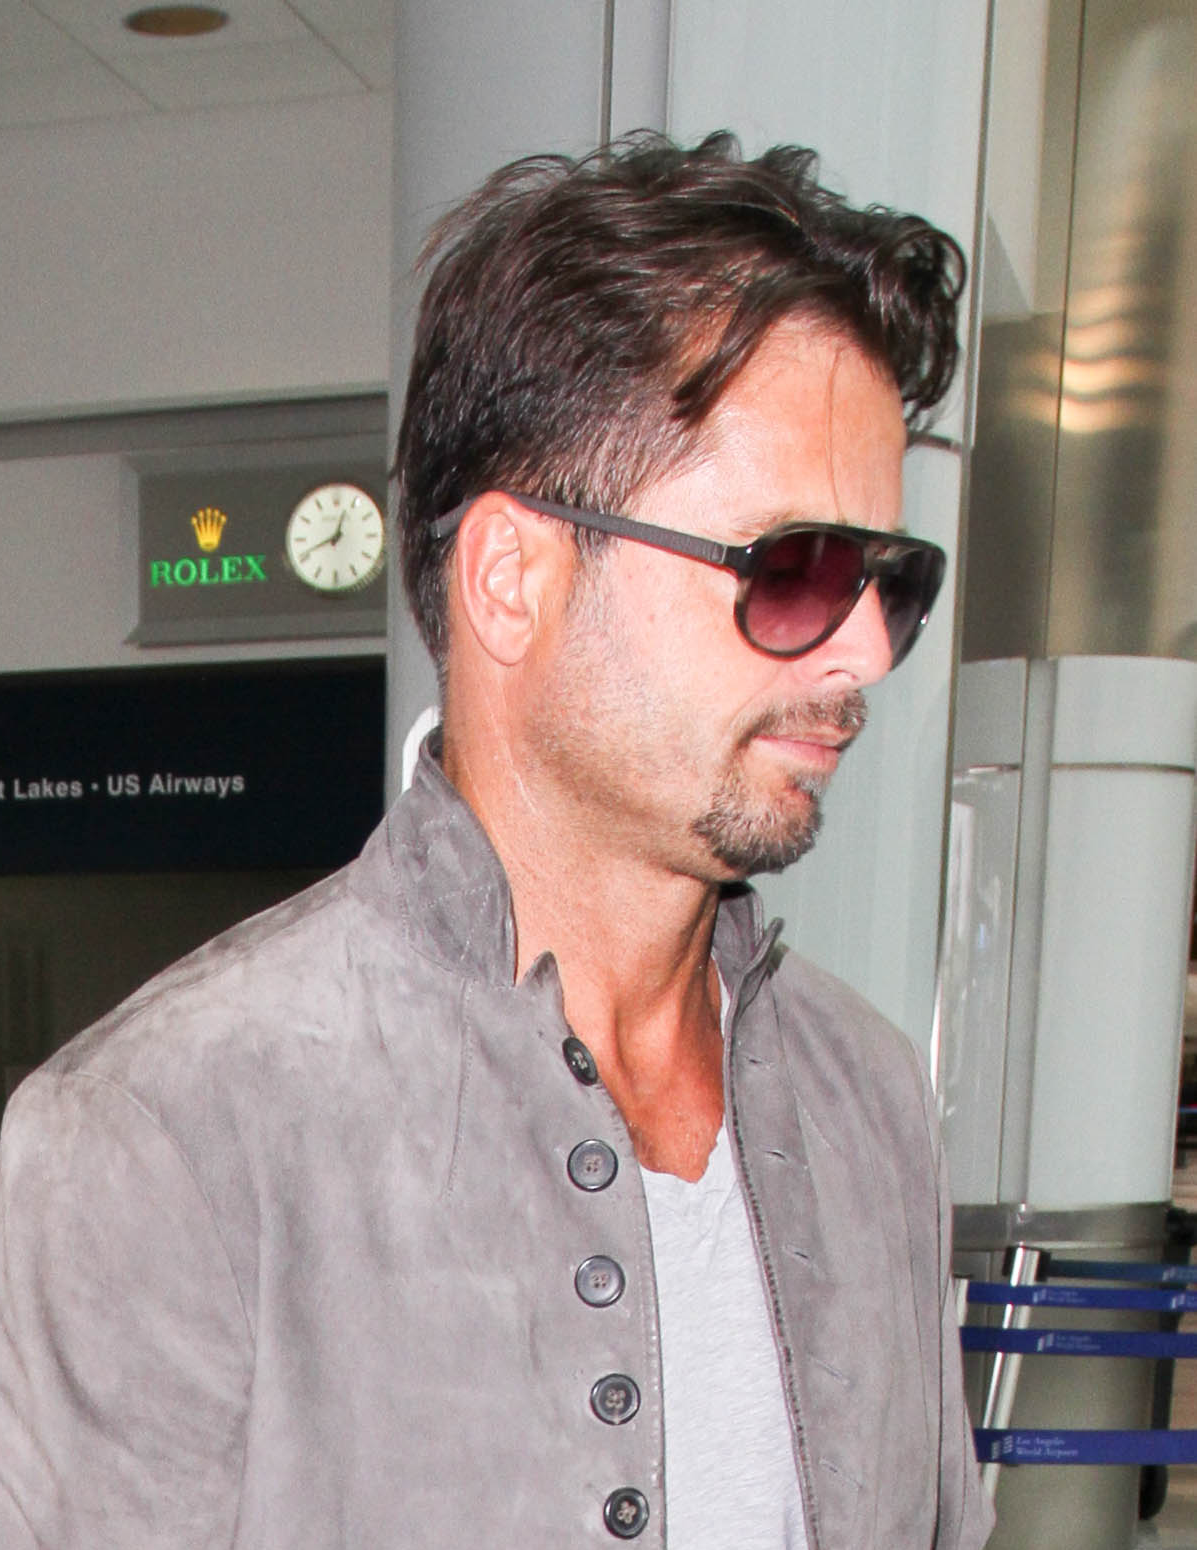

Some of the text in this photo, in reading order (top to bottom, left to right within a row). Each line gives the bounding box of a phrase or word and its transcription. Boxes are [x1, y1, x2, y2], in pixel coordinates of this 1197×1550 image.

[151, 554, 267, 587] ROLEX
[13, 777, 83, 800] Lakes
[107, 773, 140, 796] US
[148, 772, 245, 799] Airways
